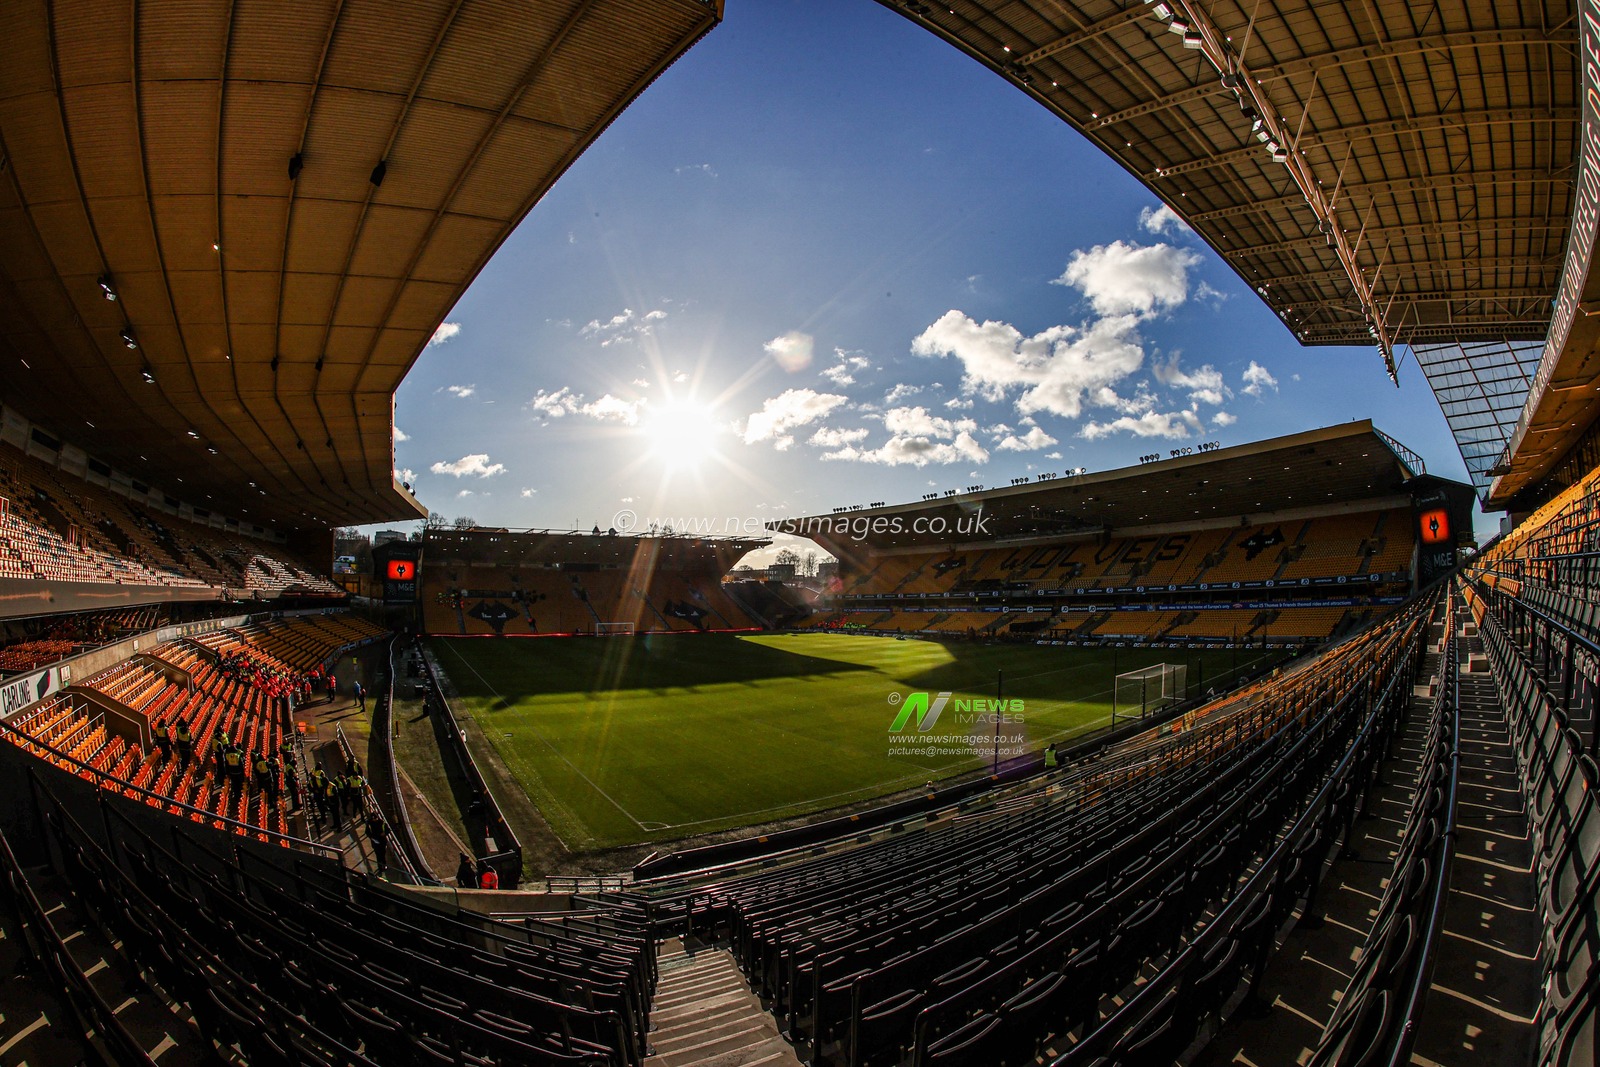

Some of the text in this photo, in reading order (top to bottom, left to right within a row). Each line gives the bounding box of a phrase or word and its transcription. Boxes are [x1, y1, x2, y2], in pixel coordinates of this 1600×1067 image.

[1552, 287, 1571, 349] GUIDES
[1565, 250, 1583, 300] OUR
[1574, 121, 1600, 263] LIFELONG
[1000, 534, 1191, 571] WOLVES
[2, 679, 31, 715] CARLING
